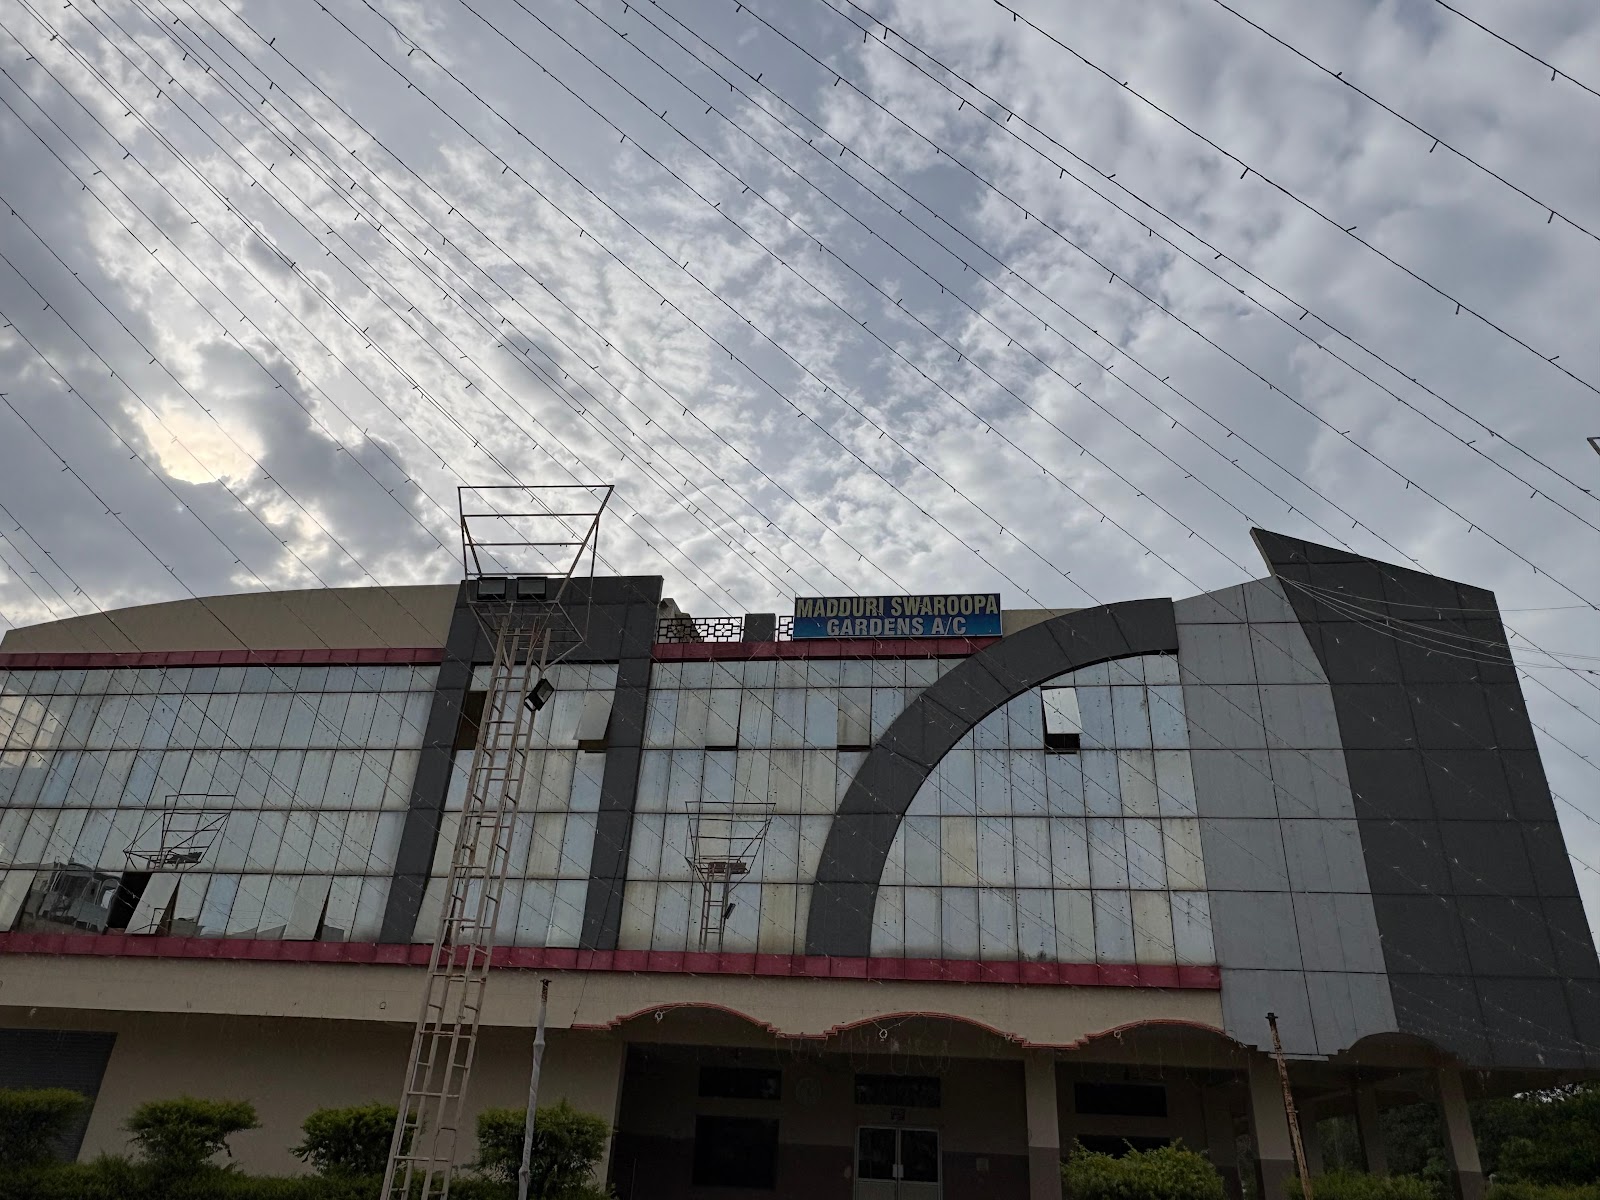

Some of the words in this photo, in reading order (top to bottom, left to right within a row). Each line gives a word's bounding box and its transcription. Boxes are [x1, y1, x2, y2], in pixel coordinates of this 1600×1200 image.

[797, 597, 884, 618] MADDURI
[891, 595, 998, 616] SWAROOPA
[827, 617, 924, 636] GARDENS
[931, 616, 966, 635] A/C
